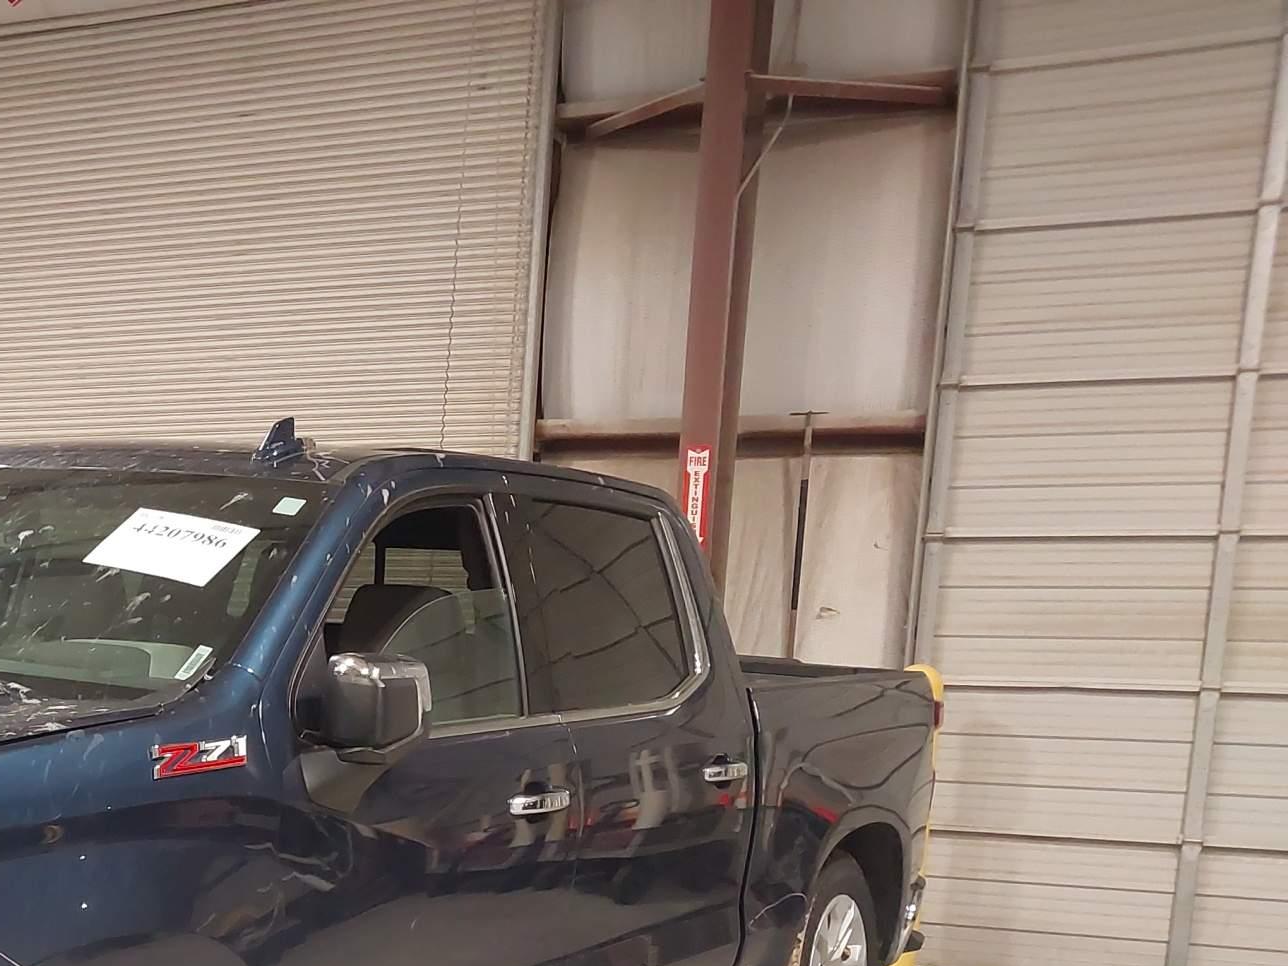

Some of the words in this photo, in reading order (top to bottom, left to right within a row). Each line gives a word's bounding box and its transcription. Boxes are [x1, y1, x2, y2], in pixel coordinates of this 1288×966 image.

[689, 456, 708, 467] FIRE
[133, 522, 228, 549] 44207986
[152, 735, 247, 780] Z71
